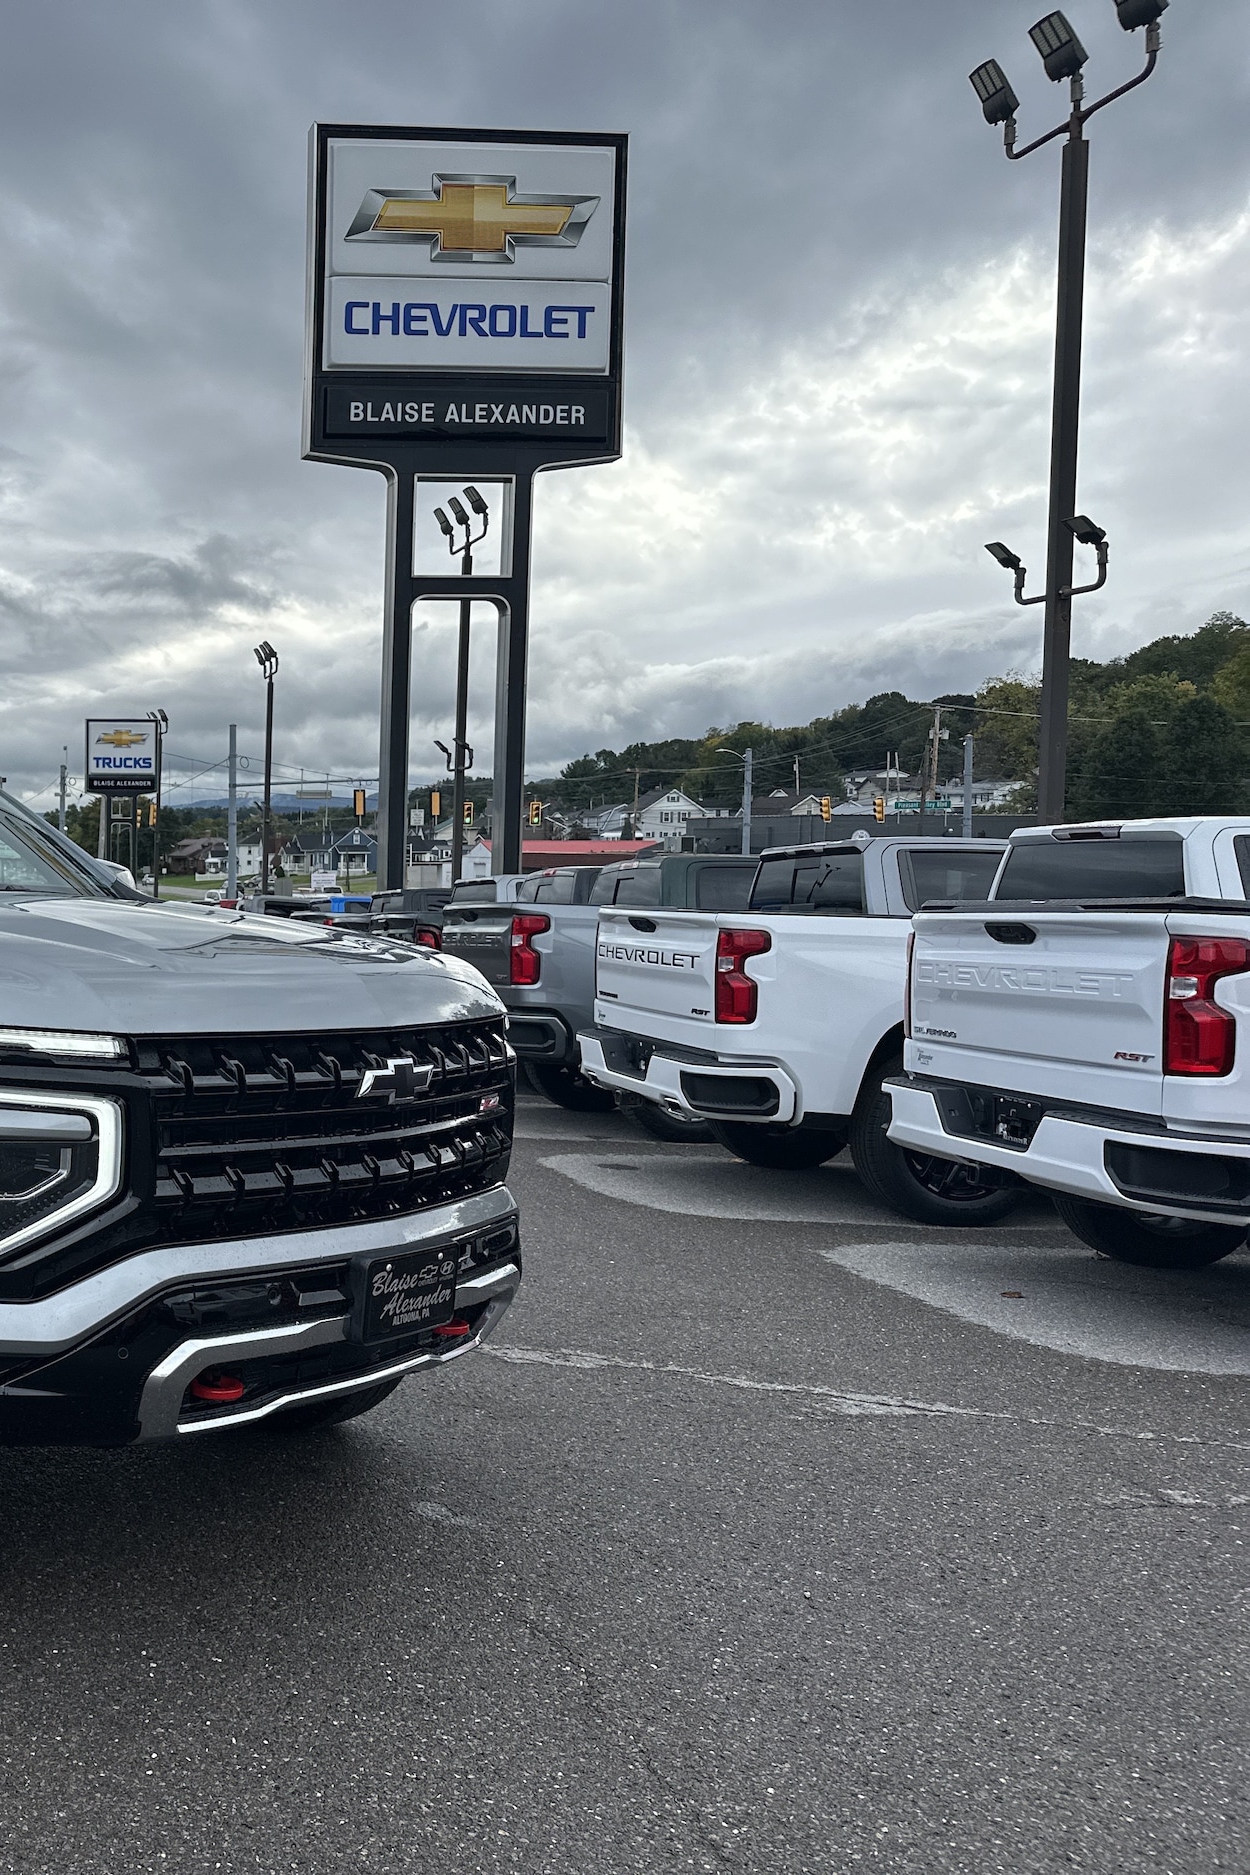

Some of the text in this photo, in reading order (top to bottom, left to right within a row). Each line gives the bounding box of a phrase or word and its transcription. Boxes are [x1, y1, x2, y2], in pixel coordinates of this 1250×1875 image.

[344, 301, 596, 339] CHEVROLET
[349, 401, 586, 426] BLAISE ALEXANDER
[92, 756, 152, 769] TRUCKS
[598, 944, 701, 969] CHEVROLET
[917, 962, 1134, 997] CHEVROLET
[691, 1008, 711, 1016] RST
[1113, 1050, 1156, 1063] RST
[372, 1271, 419, 1297] Blaise
[379, 1283, 452, 1320] Alexander
[422, 1307, 430, 1319] PA
